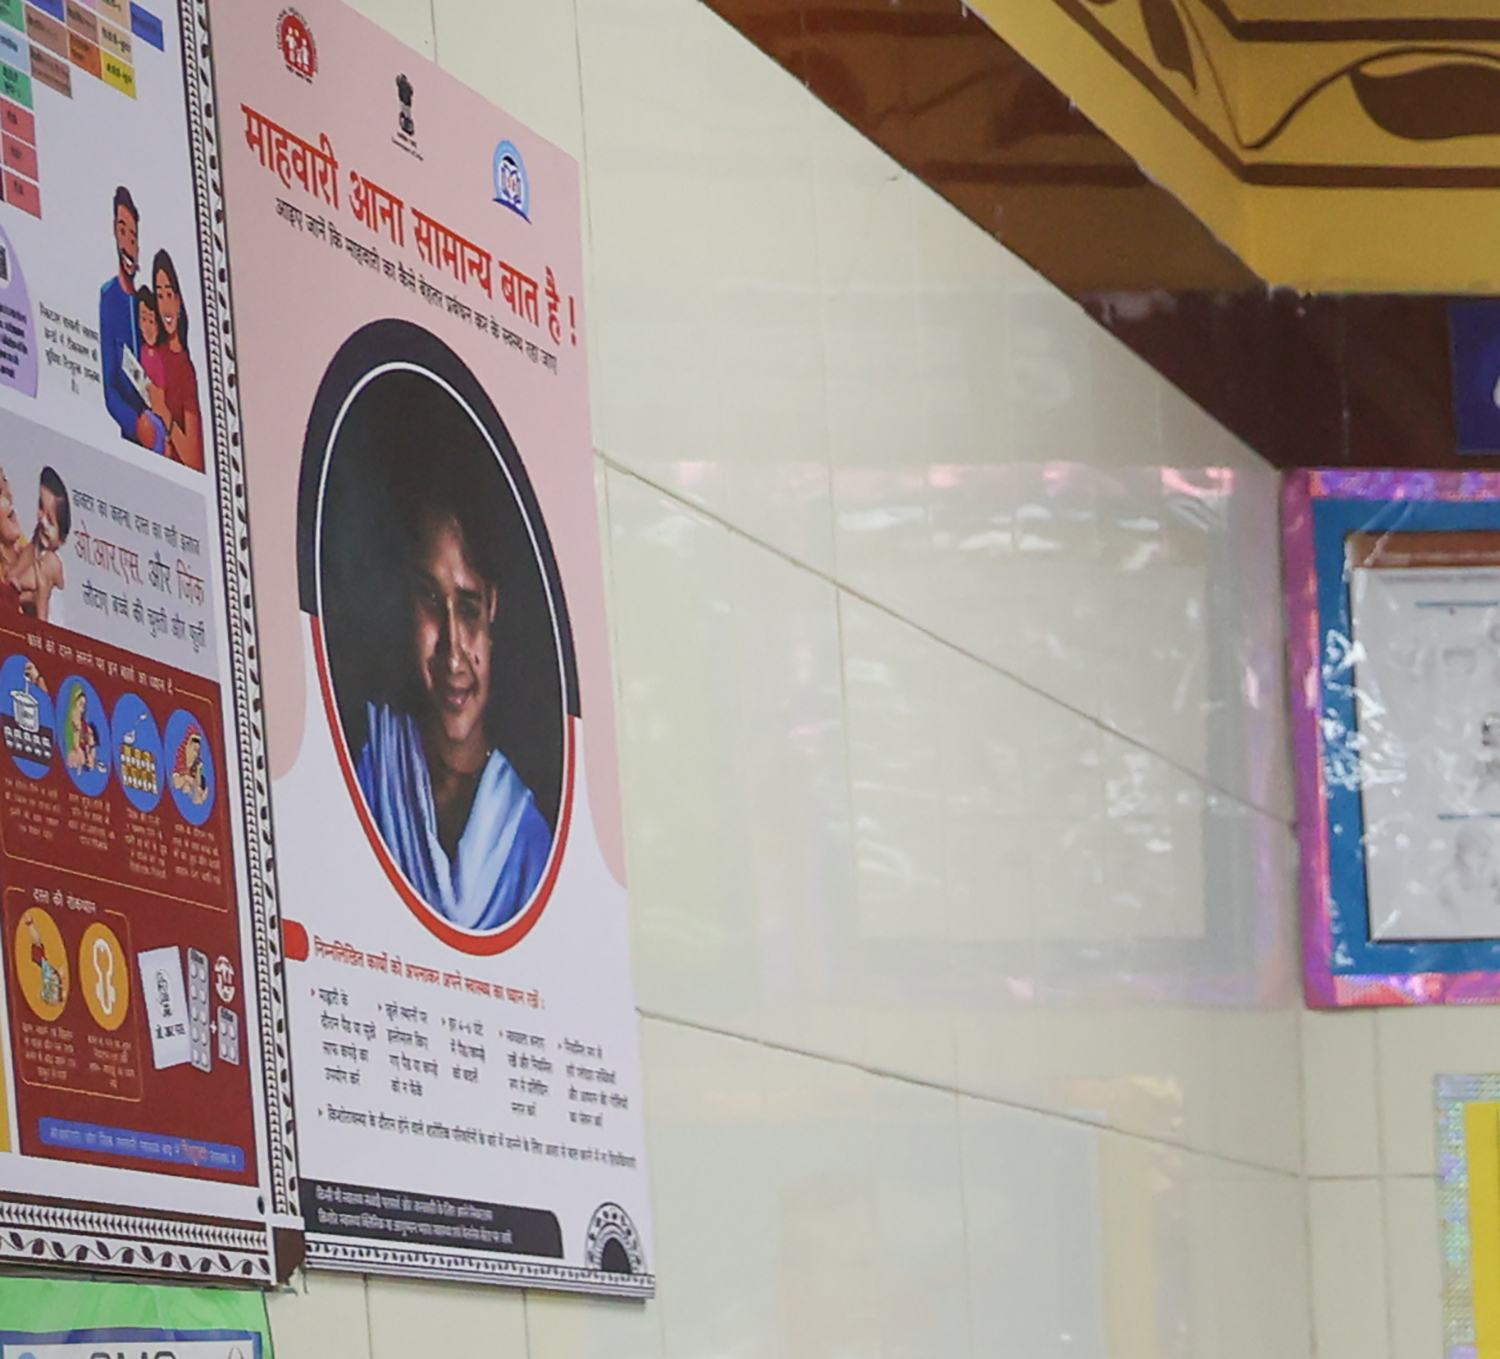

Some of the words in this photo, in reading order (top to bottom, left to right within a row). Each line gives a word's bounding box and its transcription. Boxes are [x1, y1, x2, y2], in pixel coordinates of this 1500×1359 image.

[240, 102, 339, 211] माहवारी
[349, 170, 404, 247] आना
[411, 207, 492, 300] सामान्य
[498, 260, 540, 328] बात
[545, 266, 560, 345] है
[148, 549, 172, 595] और
